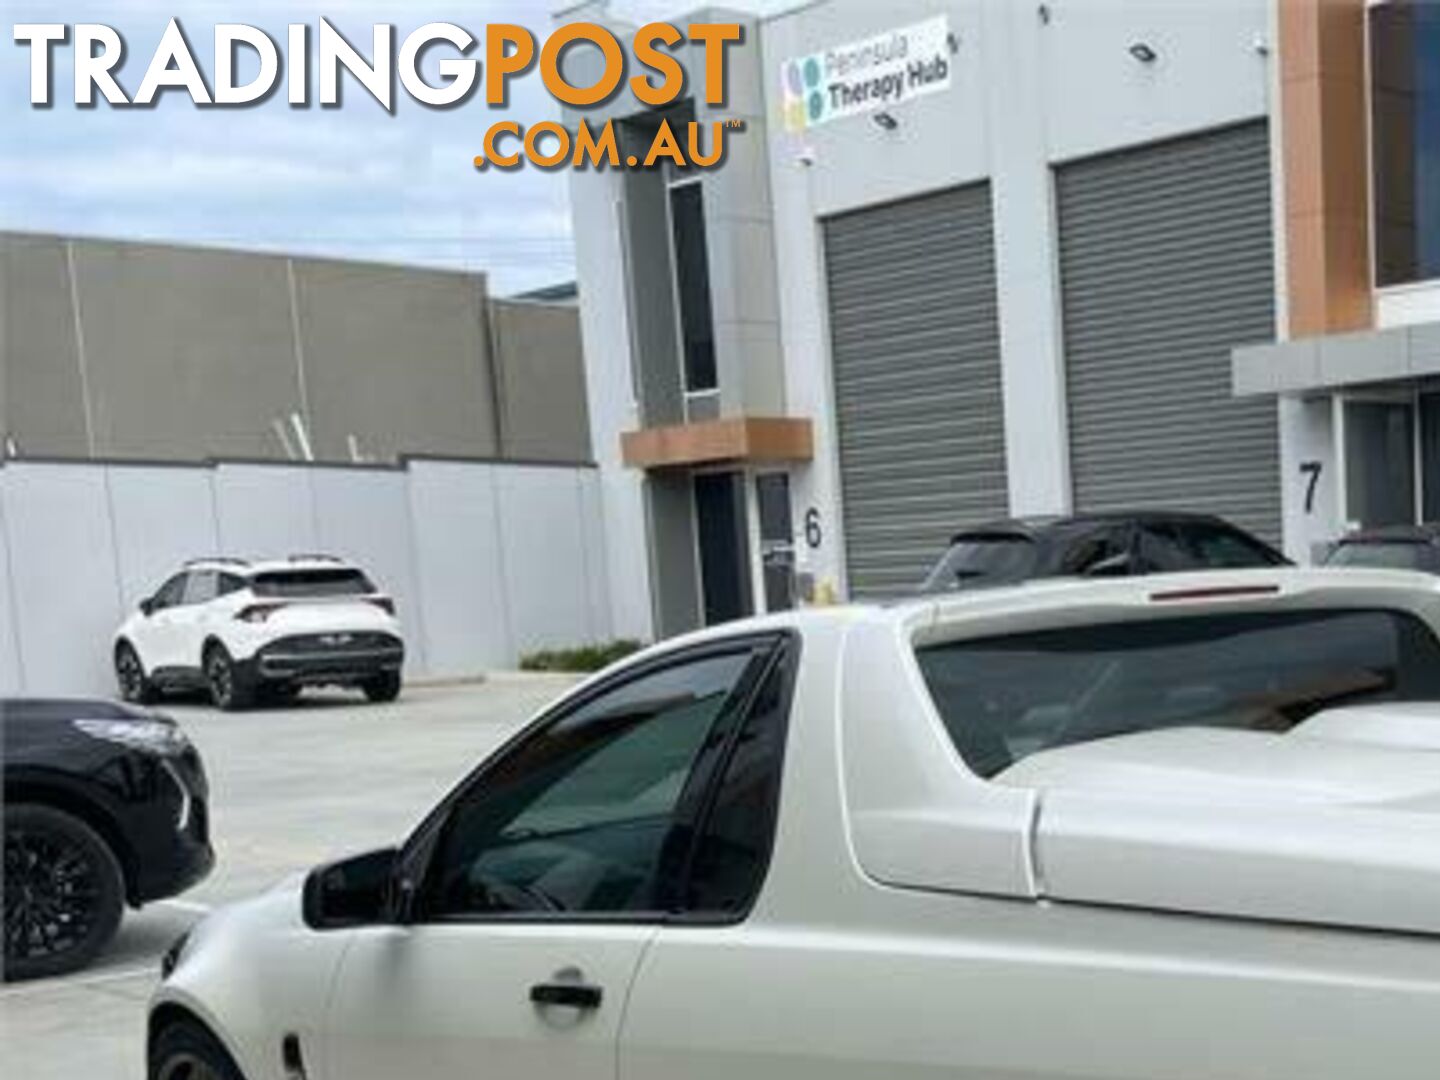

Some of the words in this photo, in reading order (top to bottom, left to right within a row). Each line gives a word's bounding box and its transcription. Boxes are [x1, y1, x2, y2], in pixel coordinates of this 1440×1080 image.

[826, 34, 908, 75] Peninsula
[828, 70, 904, 108] Therapy
[907, 54, 948, 87] Hub
[1299, 461, 1322, 514] 7
[805, 507, 822, 549] 6
